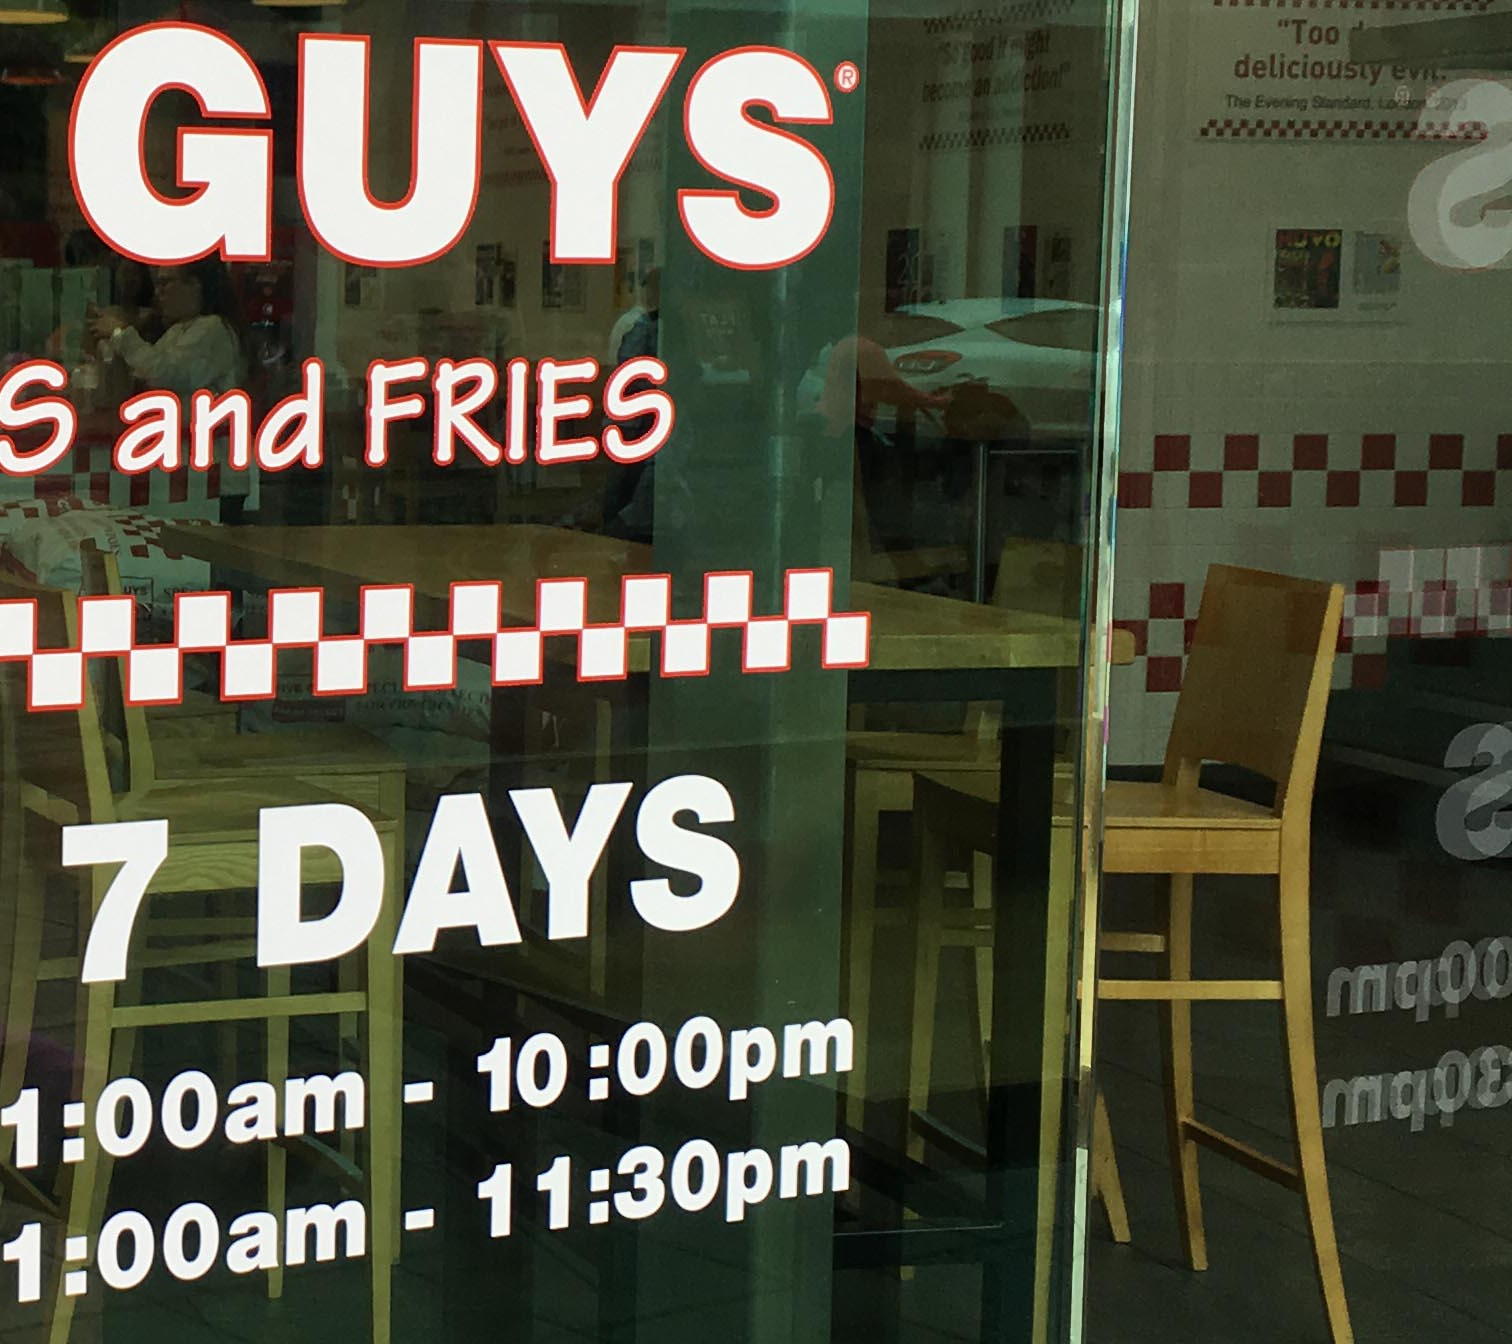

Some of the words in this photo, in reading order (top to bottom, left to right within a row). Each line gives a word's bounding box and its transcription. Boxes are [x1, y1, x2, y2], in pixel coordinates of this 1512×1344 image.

[1234, 54, 1384, 85] deliciously
[114, 357, 324, 474] and
[365, 357, 675, 467] FRIES
[63, 820, 168, 983] 7
[258, 775, 739, 967] DAYS
[479, 1139, 849, 1237] 11:30pm
